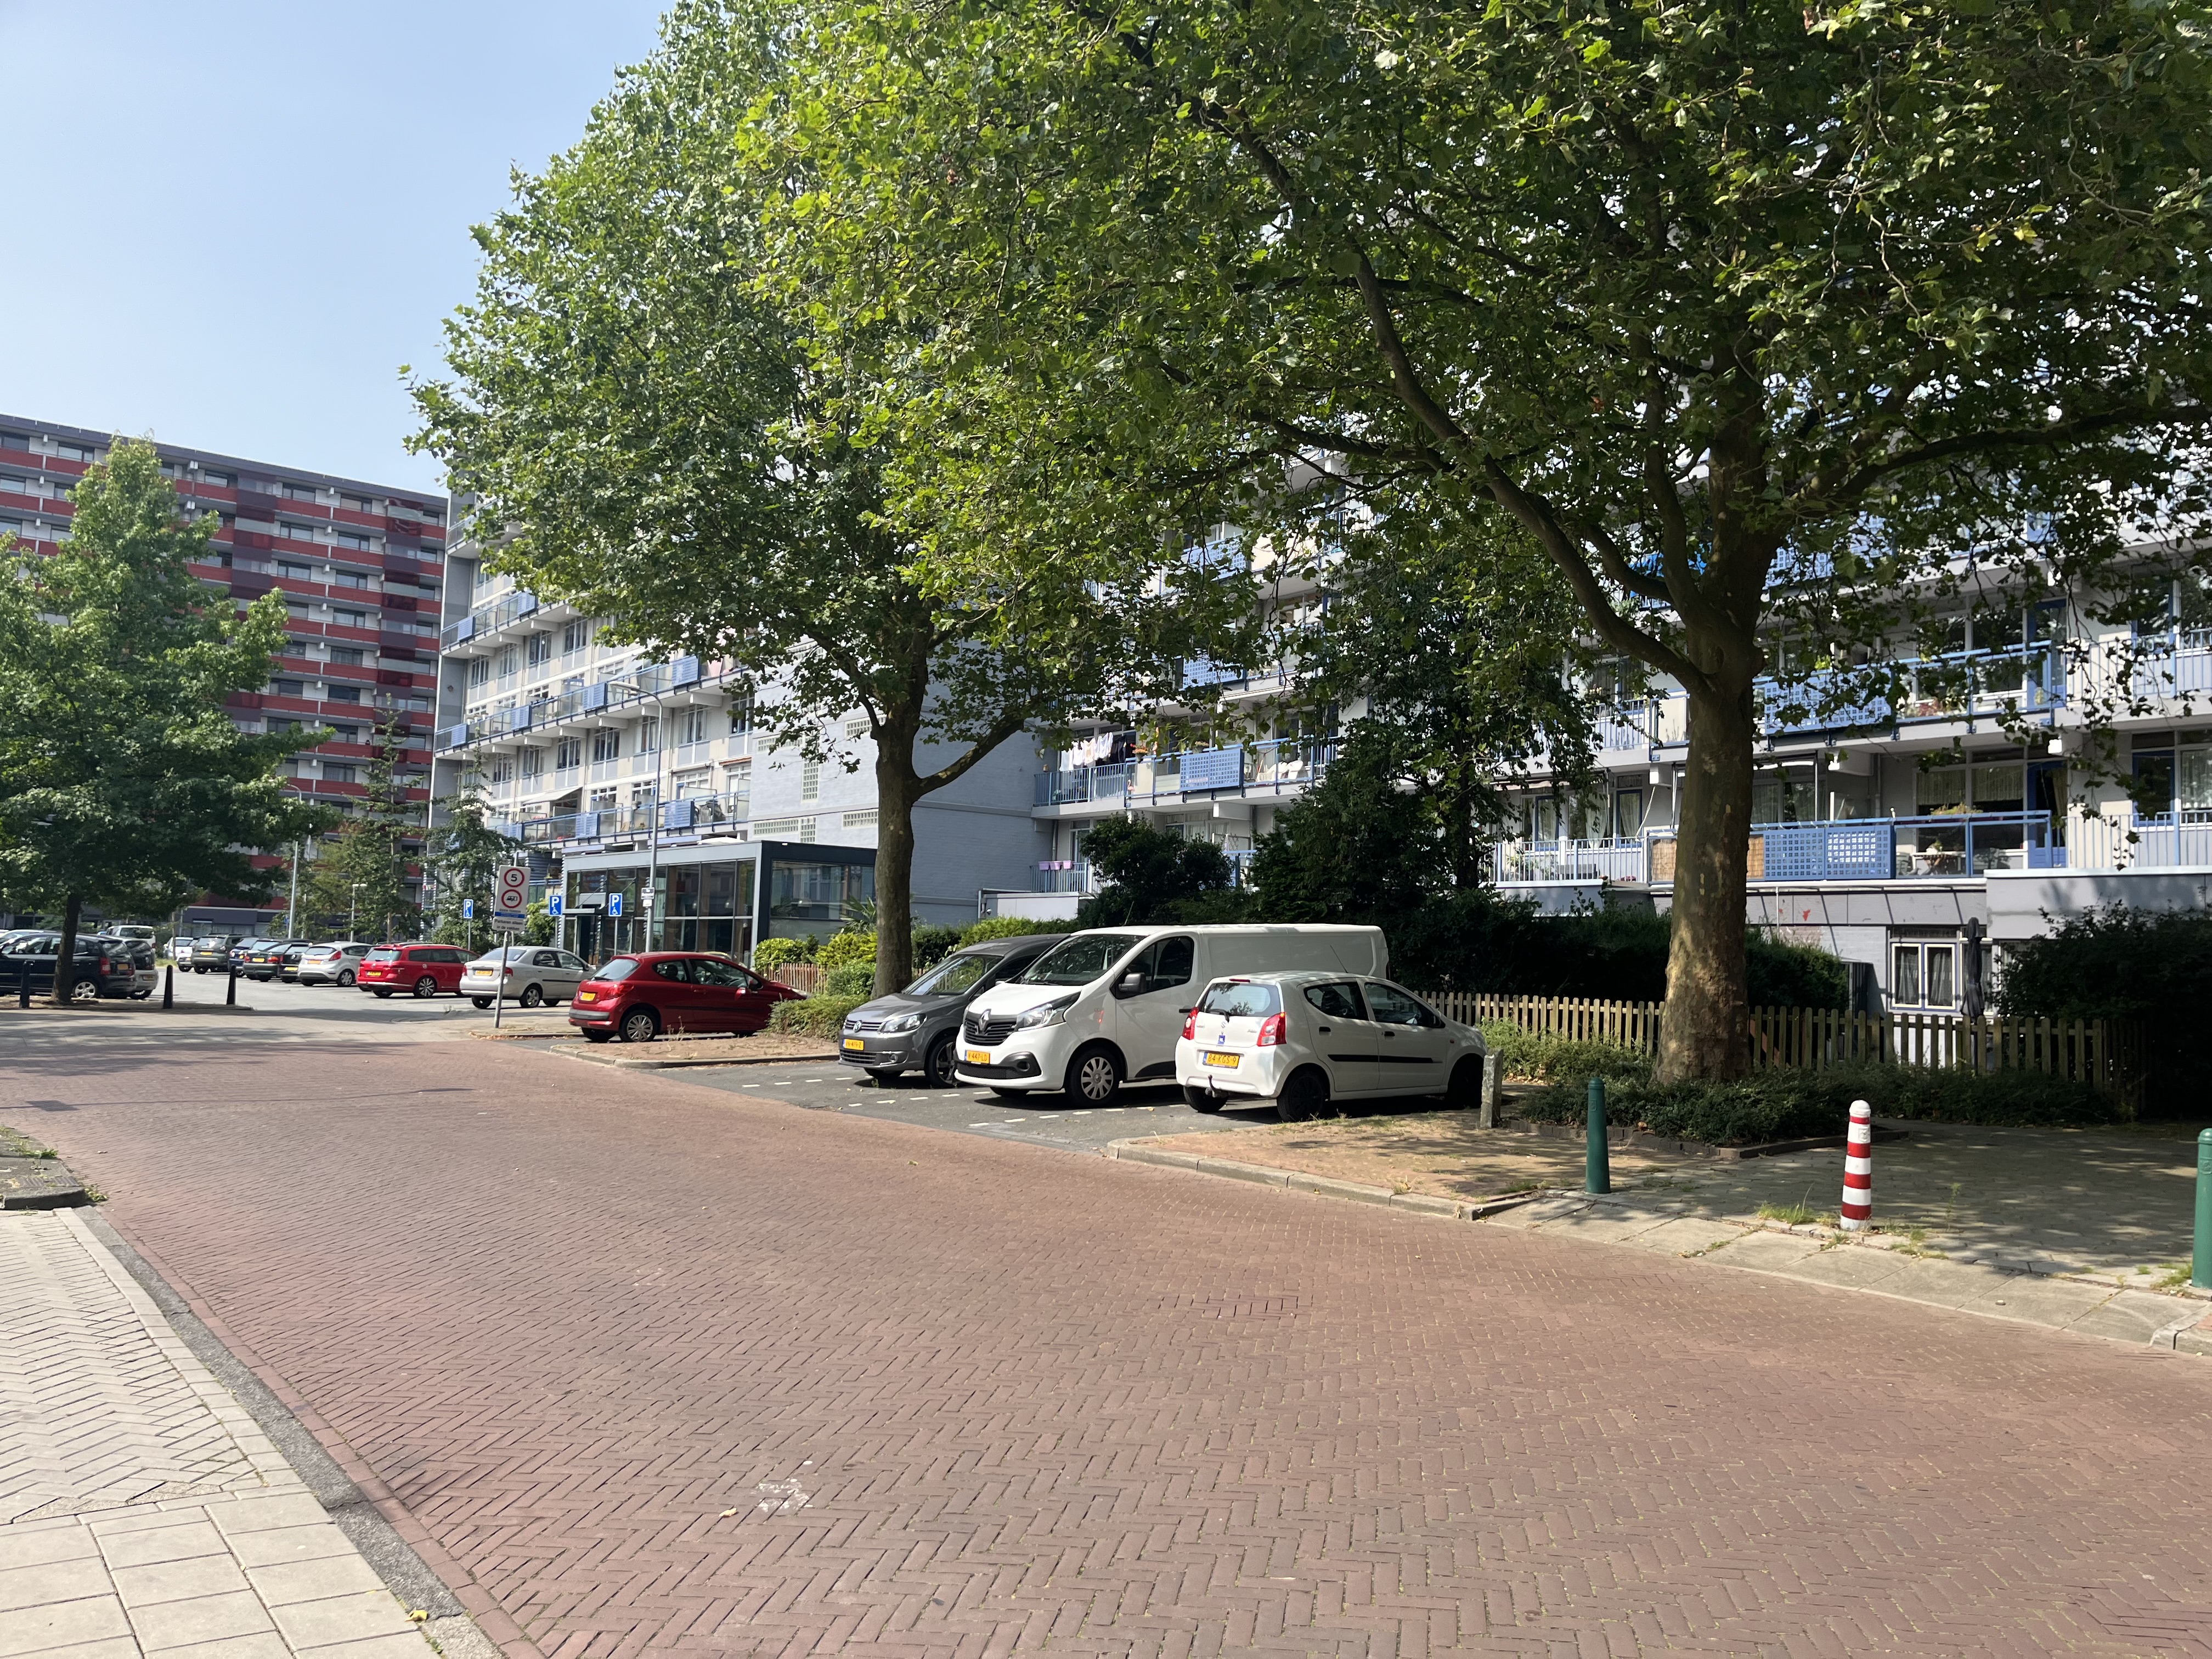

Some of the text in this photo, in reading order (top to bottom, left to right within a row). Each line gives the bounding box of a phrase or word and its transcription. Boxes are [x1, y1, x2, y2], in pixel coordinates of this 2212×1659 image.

[466, 901, 471, 910] P
[551, 896, 560, 907] P
[612, 895, 619, 907] P
[1208, 1054, 1237, 1064] 84-KGS-9
